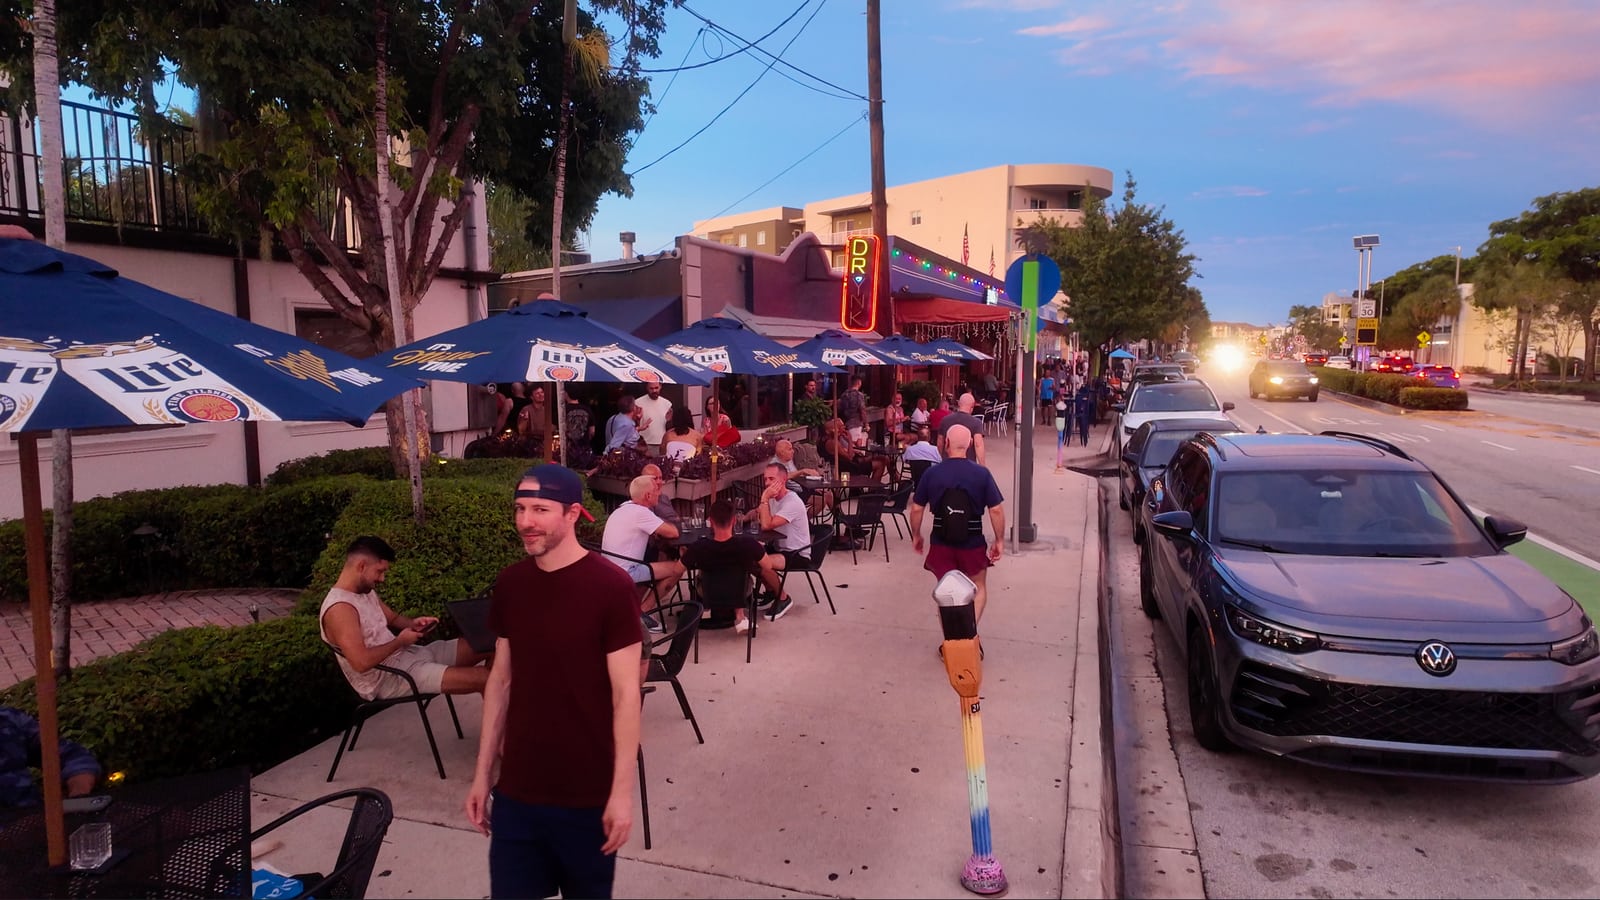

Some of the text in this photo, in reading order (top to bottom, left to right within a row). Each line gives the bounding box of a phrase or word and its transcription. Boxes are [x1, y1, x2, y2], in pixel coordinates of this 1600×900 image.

[542, 350, 584, 364] Lite
[599, 354, 640, 368] Lite
[88, 358, 203, 393] Lite
